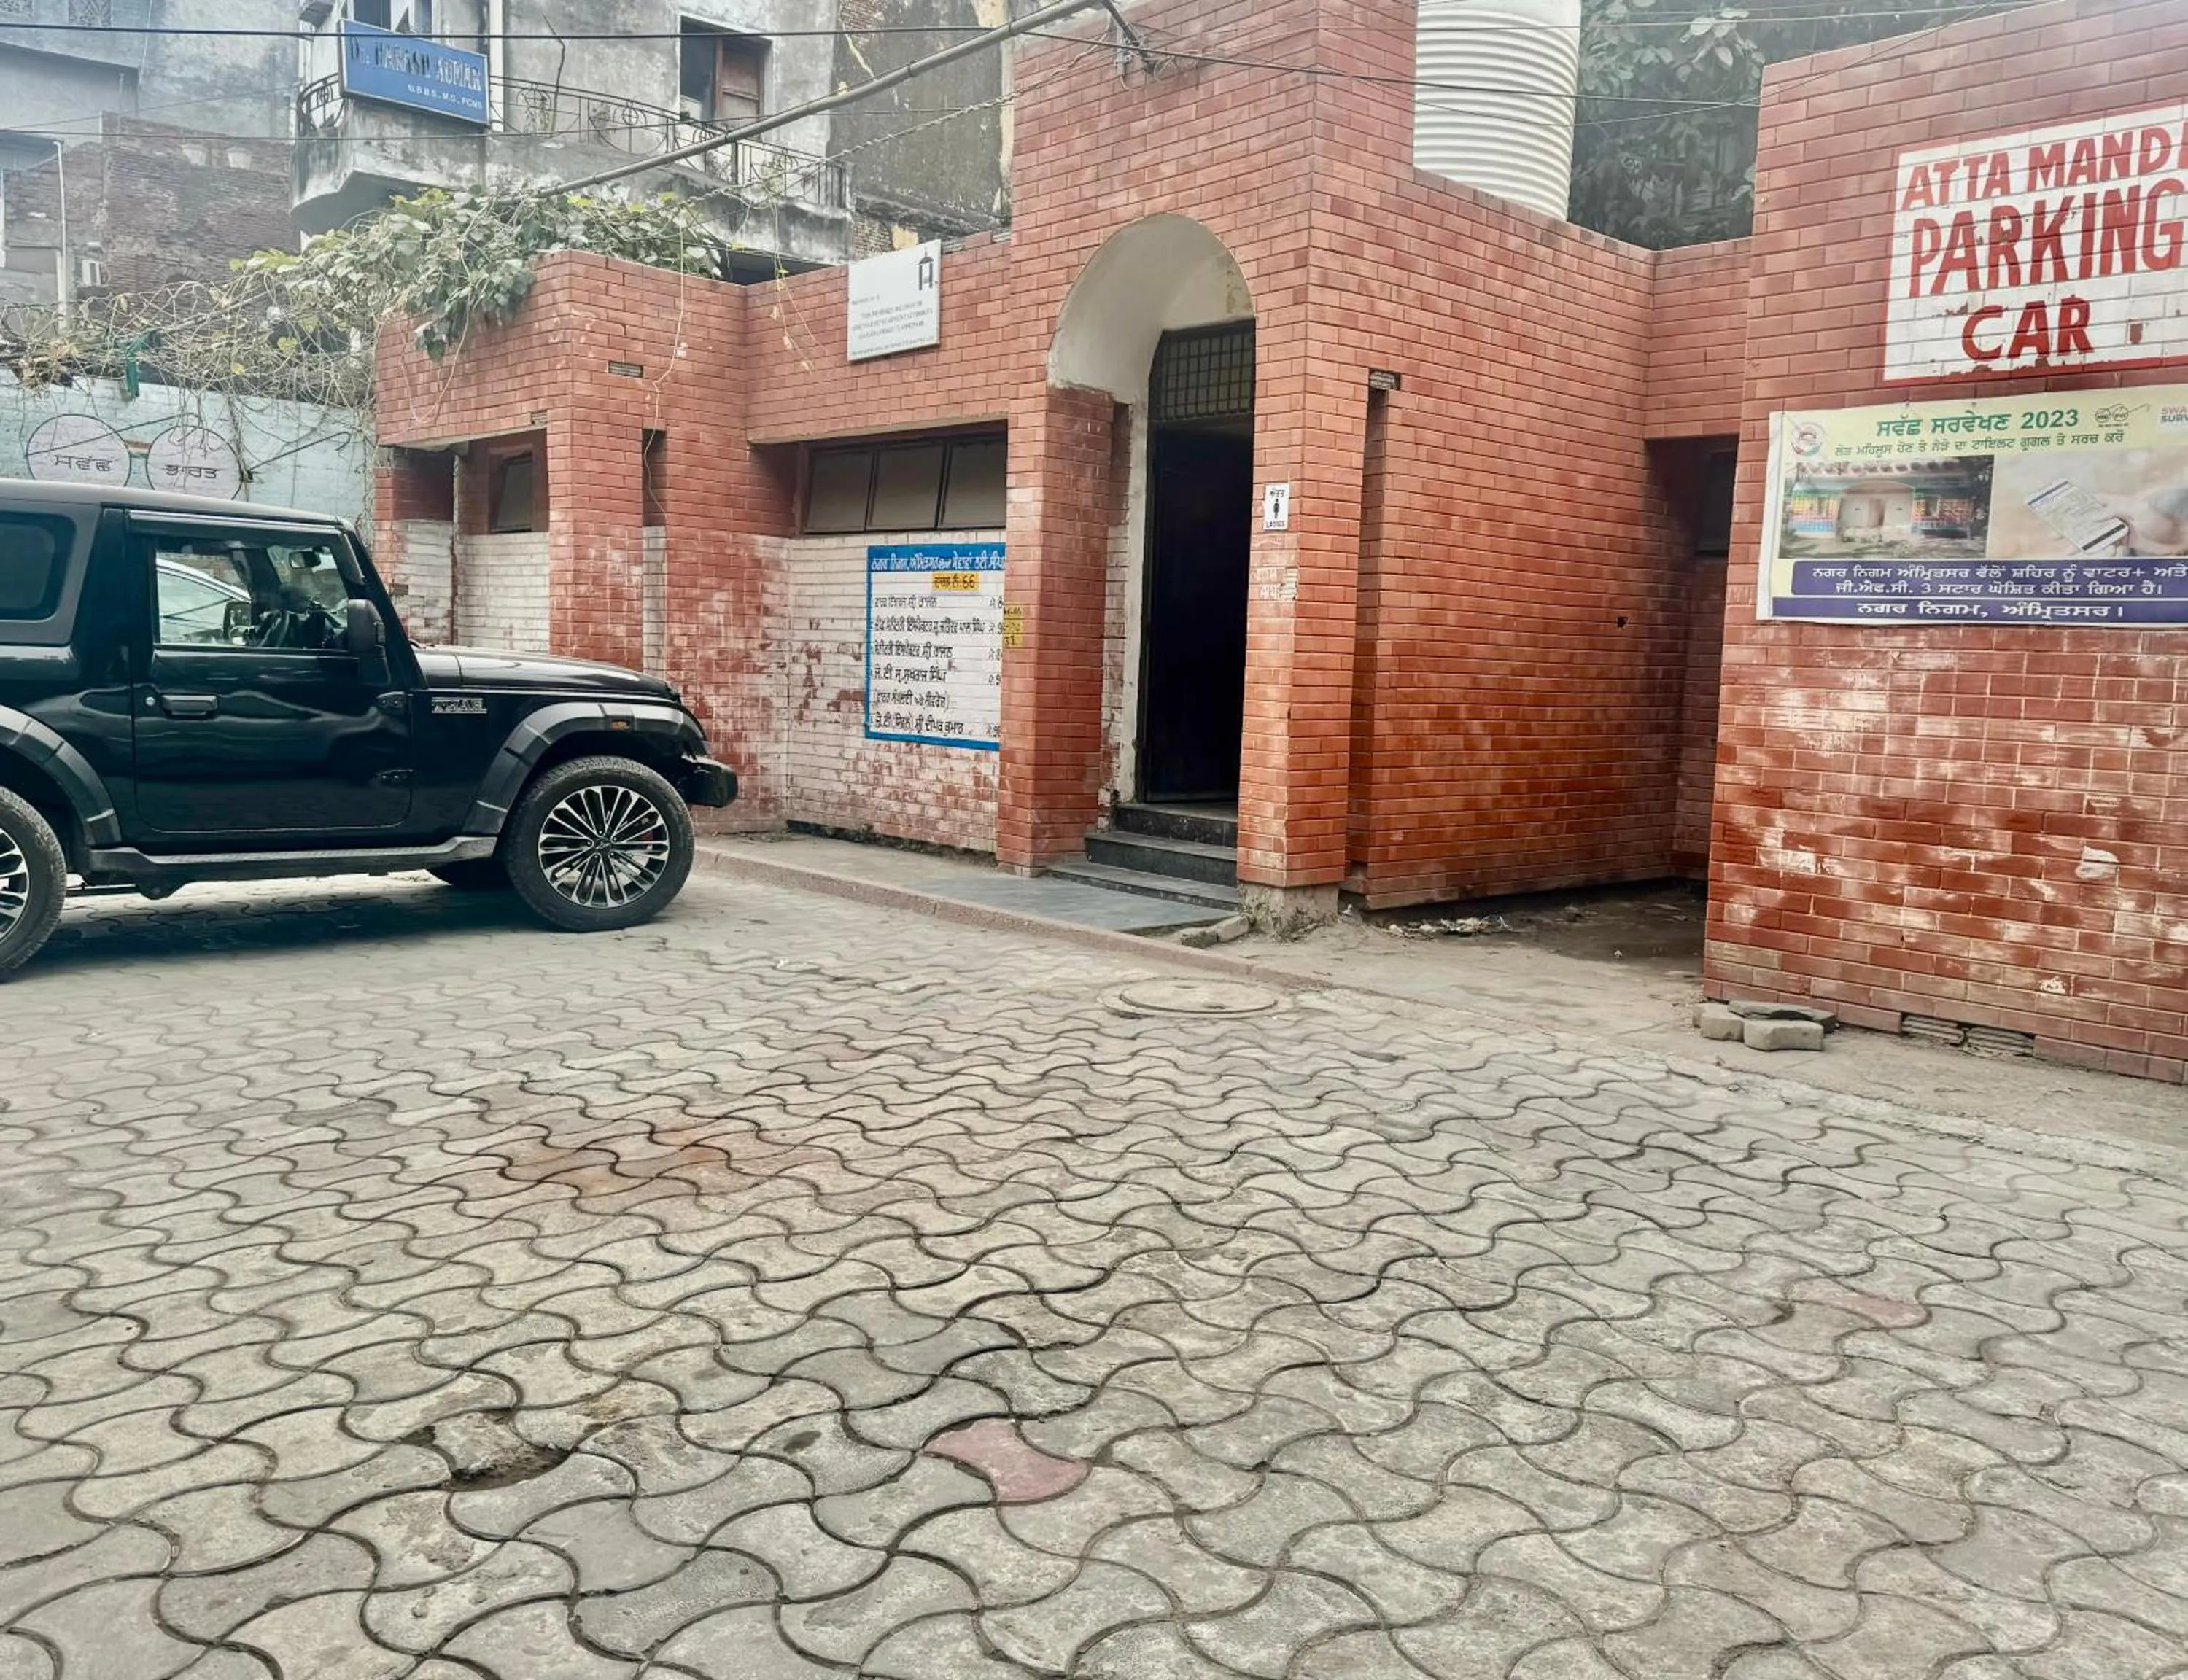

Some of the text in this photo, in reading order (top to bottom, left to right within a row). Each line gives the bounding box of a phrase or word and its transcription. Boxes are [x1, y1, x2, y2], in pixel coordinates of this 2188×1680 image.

[1901, 152, 2011, 211] ATTA
[1909, 177, 2185, 299] PARKING
[1962, 296, 2095, 362] CAR
[1877, 409, 2079, 437] ਸਵੱਛ ਸਰਵੇਖਣ 2023
[1955, 440, 1967, 451] ਦਾ
[1971, 436, 2015, 451] ਟਾਇਲਟ
[2071, 434, 2098, 446] ਸਰਚ
[54, 454, 115, 472] ਸਵੱਛ
[1812, 567, 1848, 578] ਨਗਰ
[1853, 564, 1893, 578] ਨਿਗਮ
[1897, 564, 1971, 581] ਅੰਮ੍ਰਿਤਸਰ
[2063, 564, 2079, 583] ਨੂੰ
[2154, 563, 2188, 578] ਅਤੇ
[1920, 583, 1931, 594] 3
[1938, 583, 1983, 594] ਸਟਾਰ
[2041, 581, 2082, 595] ਕੀਤਾ
[2087, 581, 2135, 595] ਗਿਆ
[1857, 602, 1908, 615] ਨਗਰ
[1917, 600, 1989, 618] ਨਿਗਮ,
